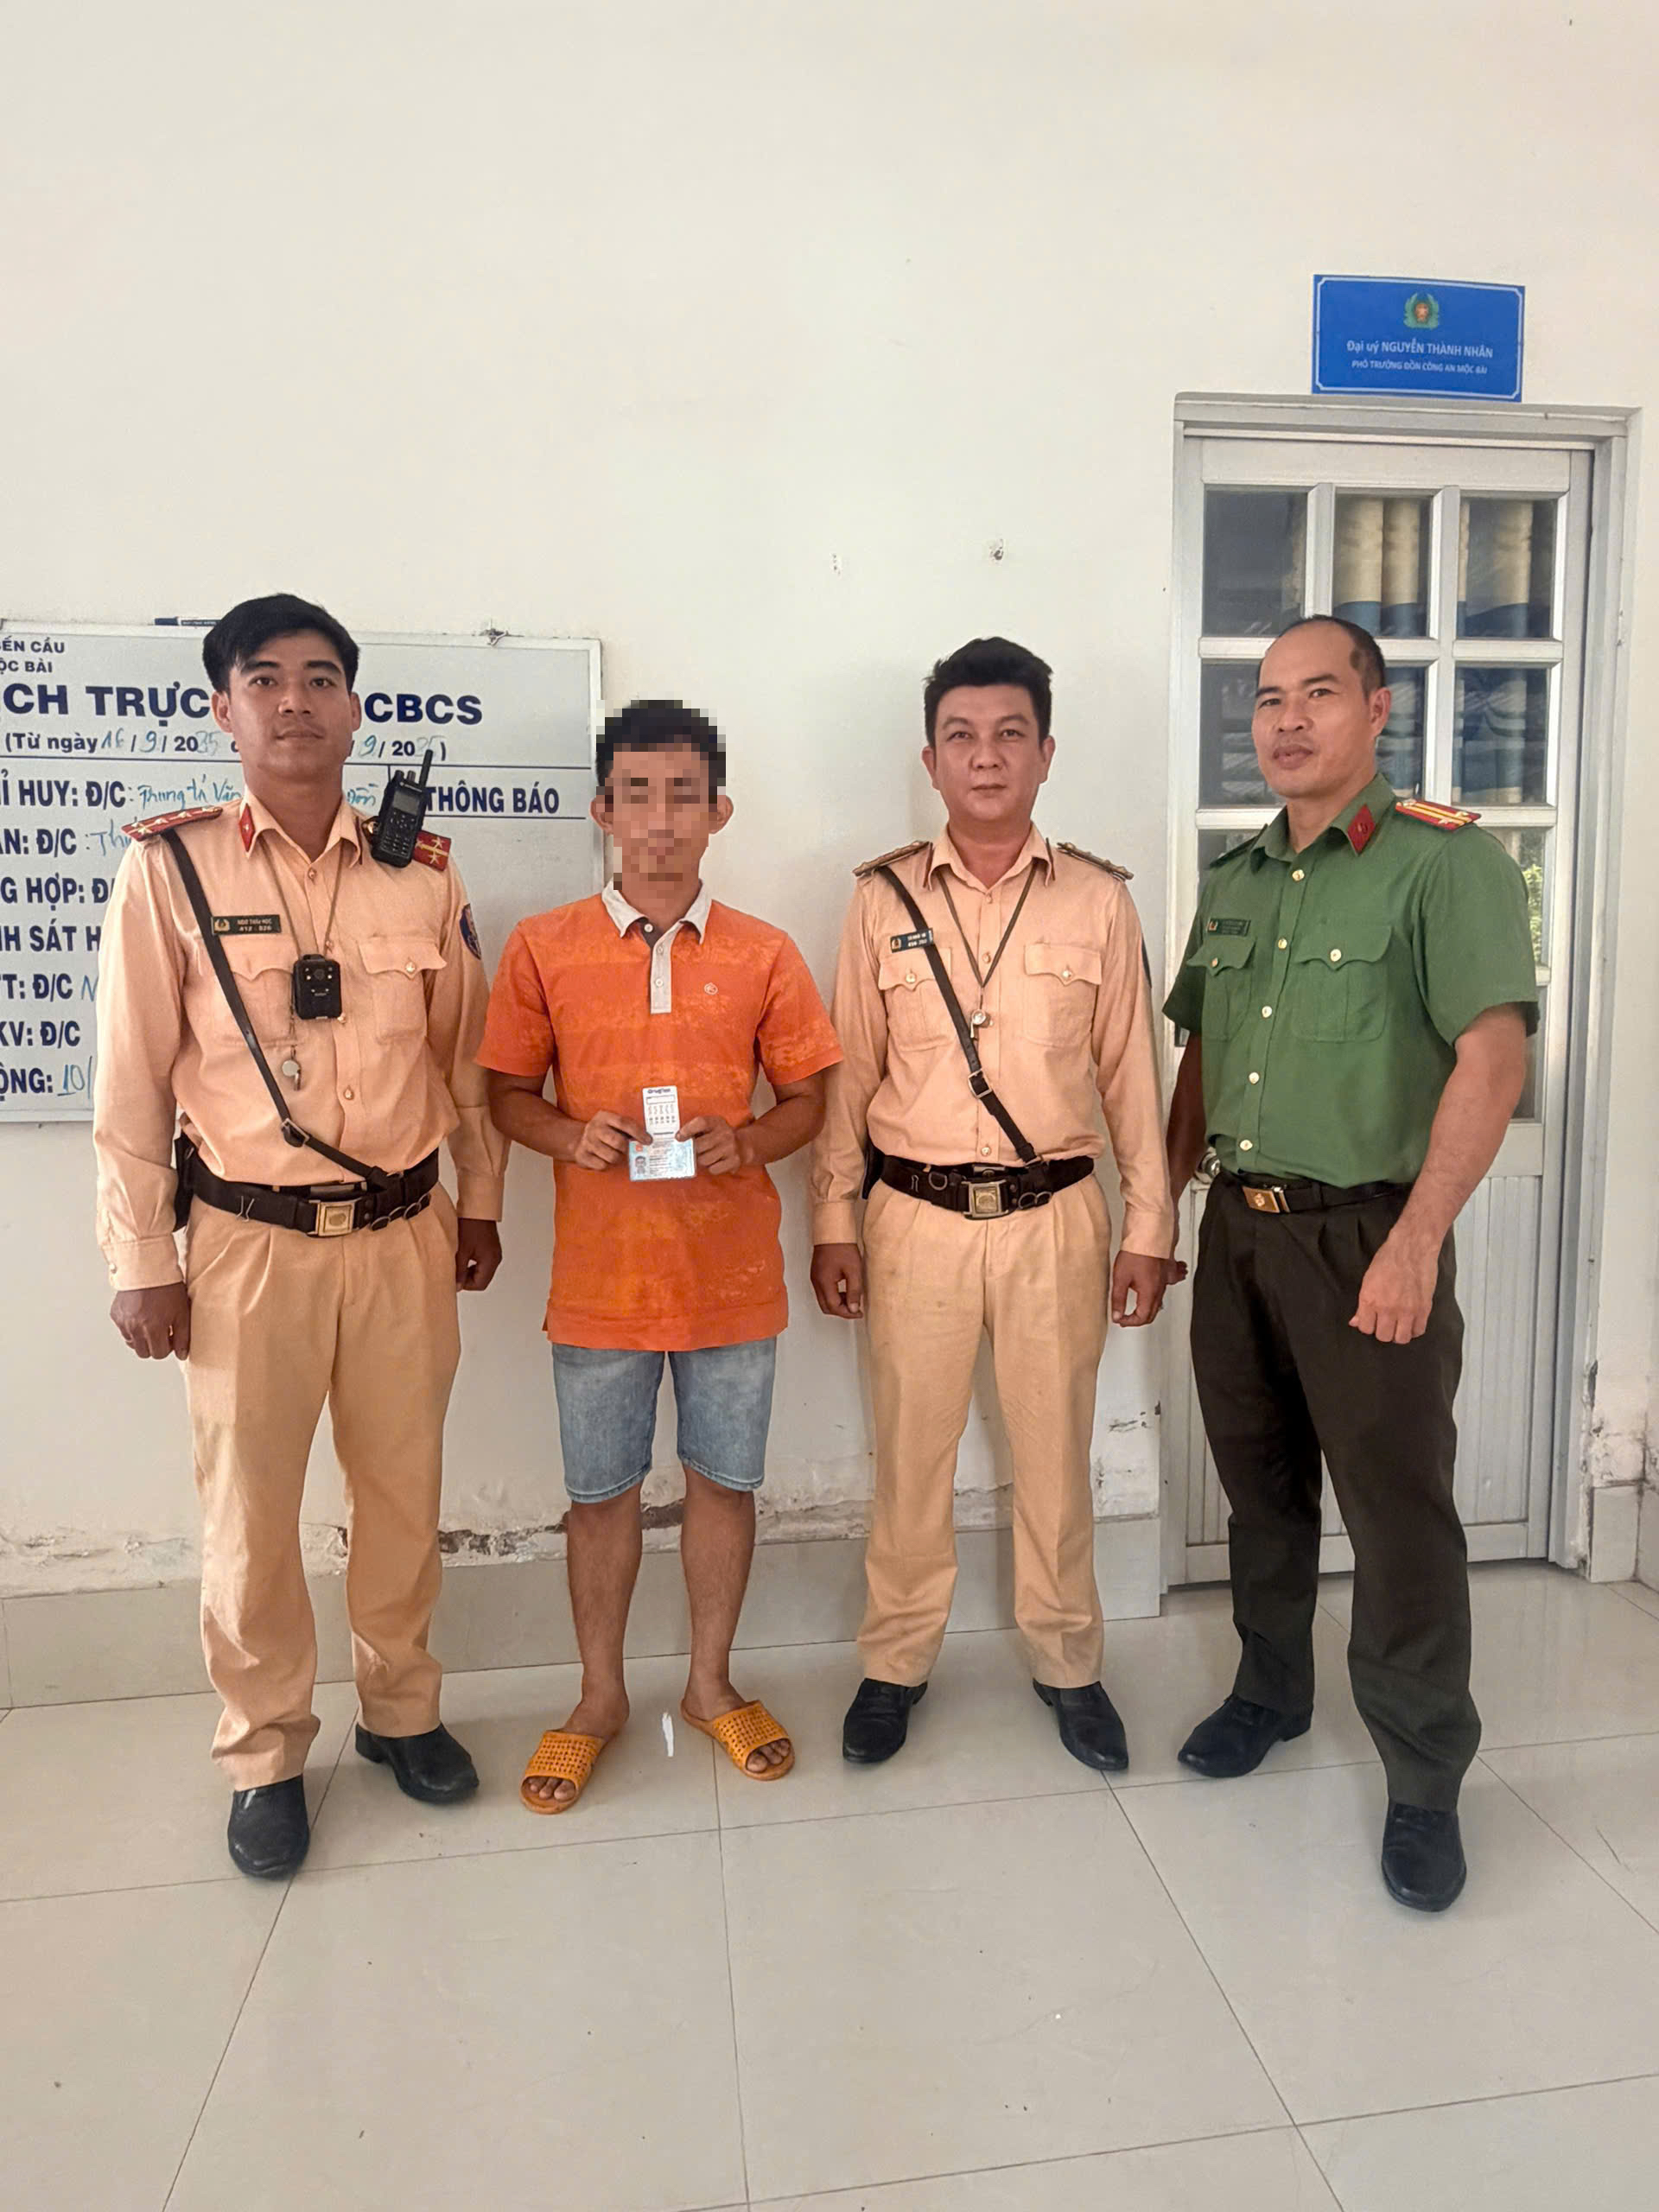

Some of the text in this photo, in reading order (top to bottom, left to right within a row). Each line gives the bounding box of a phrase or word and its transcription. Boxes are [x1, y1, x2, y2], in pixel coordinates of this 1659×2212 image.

[1346, 340, 1363, 354] Đại
[1381, 338, 1425, 353] NGUYỄN
[1427, 341, 1462, 356] THÀNH
[1422, 361, 1444, 372] CÔNG
[1445, 364, 1456, 372] AN
[0, 635, 25, 652] ẾN
[24, 658, 53, 673] BÀI
[3, 681, 483, 728] CH TRỰC CBCS
[5, 732, 41, 753] (Từ
[48, 732, 98, 753] ngày
[18, 779, 78, 807] HUY:
[427, 780, 504, 814] THÔNG
[512, 781, 560, 815] BÁO
[0, 828, 29, 855] N:
[25, 872, 85, 912] HỢP:
[0, 925, 22, 952] H
[29, 918, 78, 952] SÁT
[32, 973, 73, 1002] Đ/C
[40, 1020, 81, 1049] Đ/C
